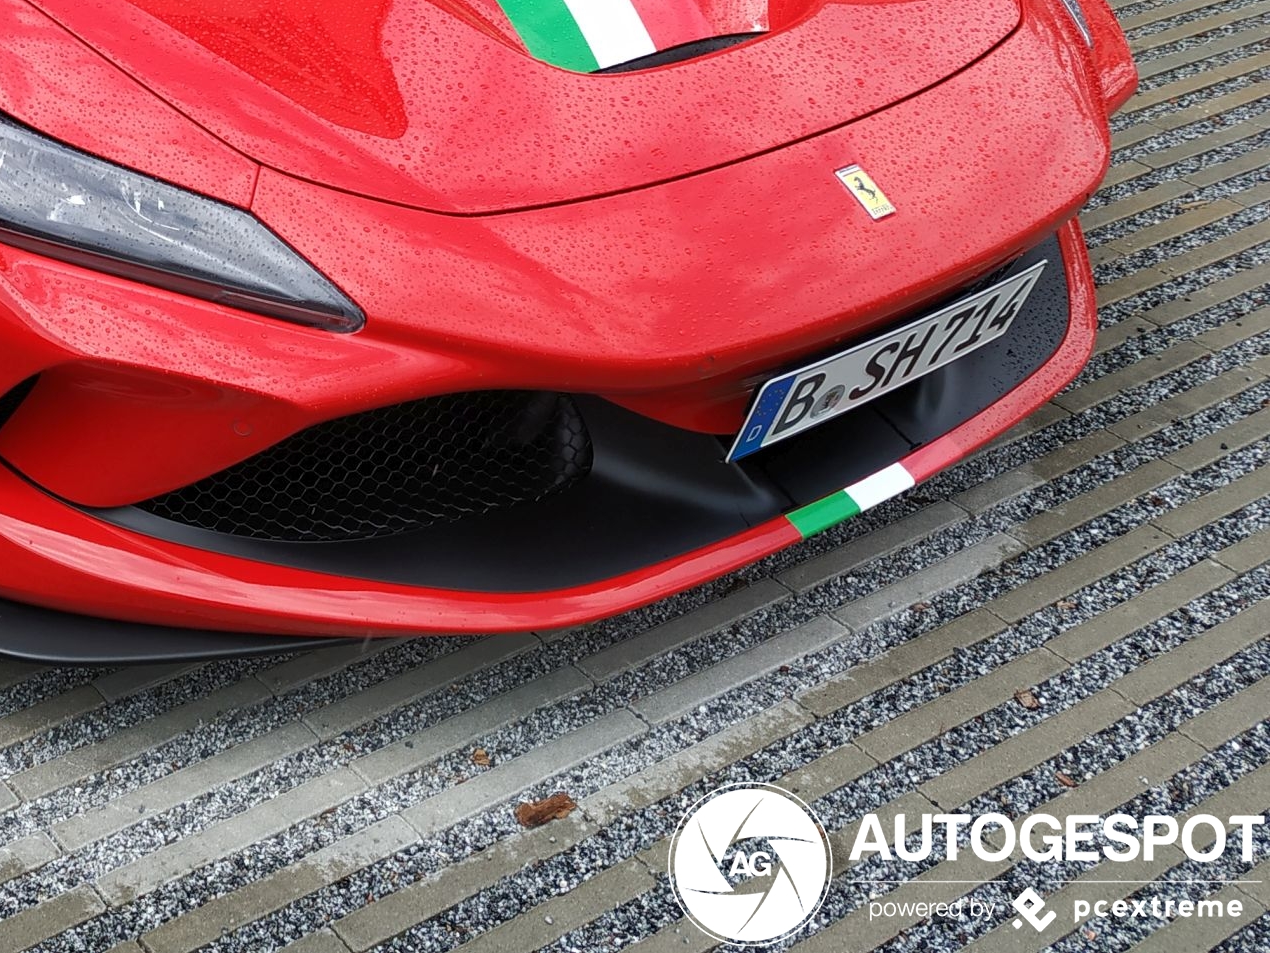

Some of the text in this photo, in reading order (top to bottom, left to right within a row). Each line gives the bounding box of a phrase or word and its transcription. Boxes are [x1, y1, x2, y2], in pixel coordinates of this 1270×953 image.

[771, 276, 1033, 436] B SH 714
[745, 424, 763, 443] D
